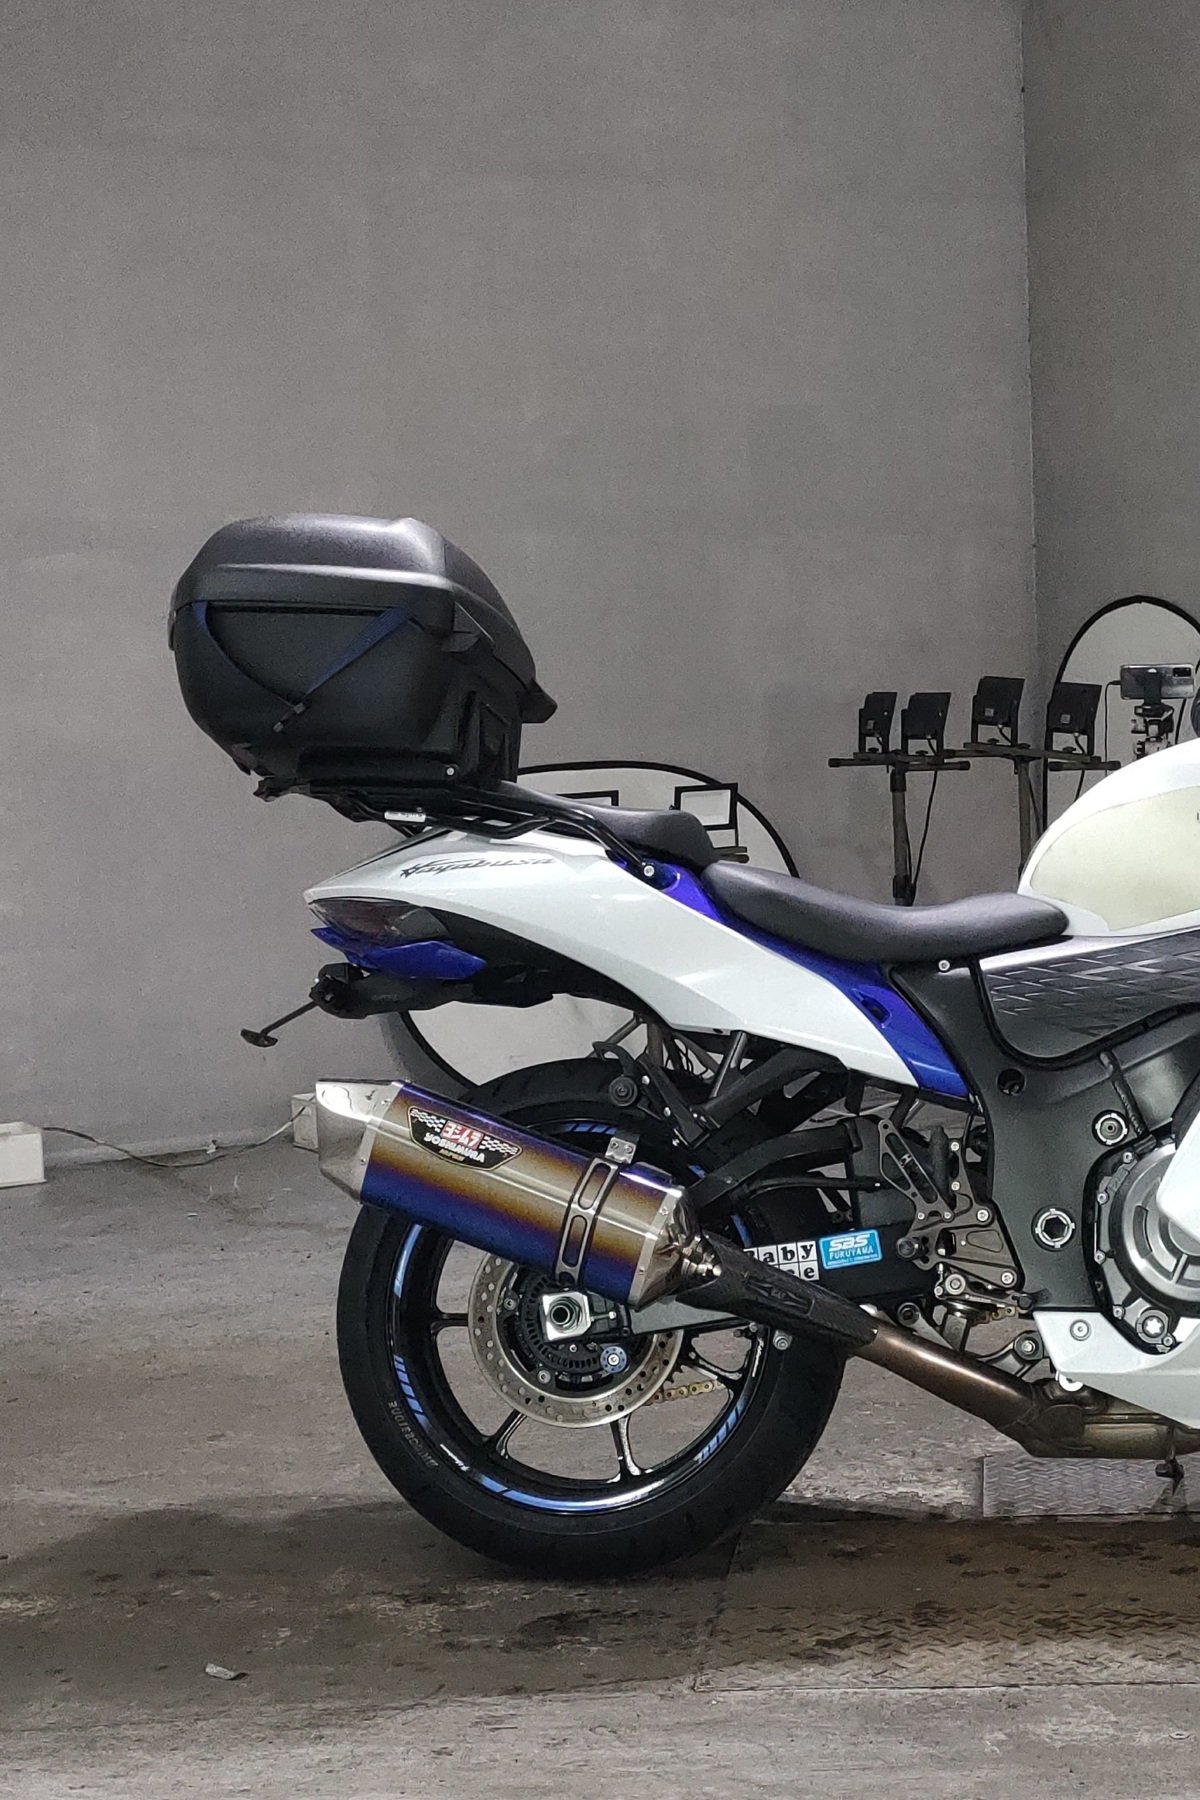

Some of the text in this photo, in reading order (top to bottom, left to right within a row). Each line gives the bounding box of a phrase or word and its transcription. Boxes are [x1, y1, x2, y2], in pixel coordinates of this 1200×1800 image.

[423, 1132, 485, 1163] YOSHIMURA
[829, 1234, 870, 1251] SBS
[829, 1245, 874, 1260] FUKUYAMA
